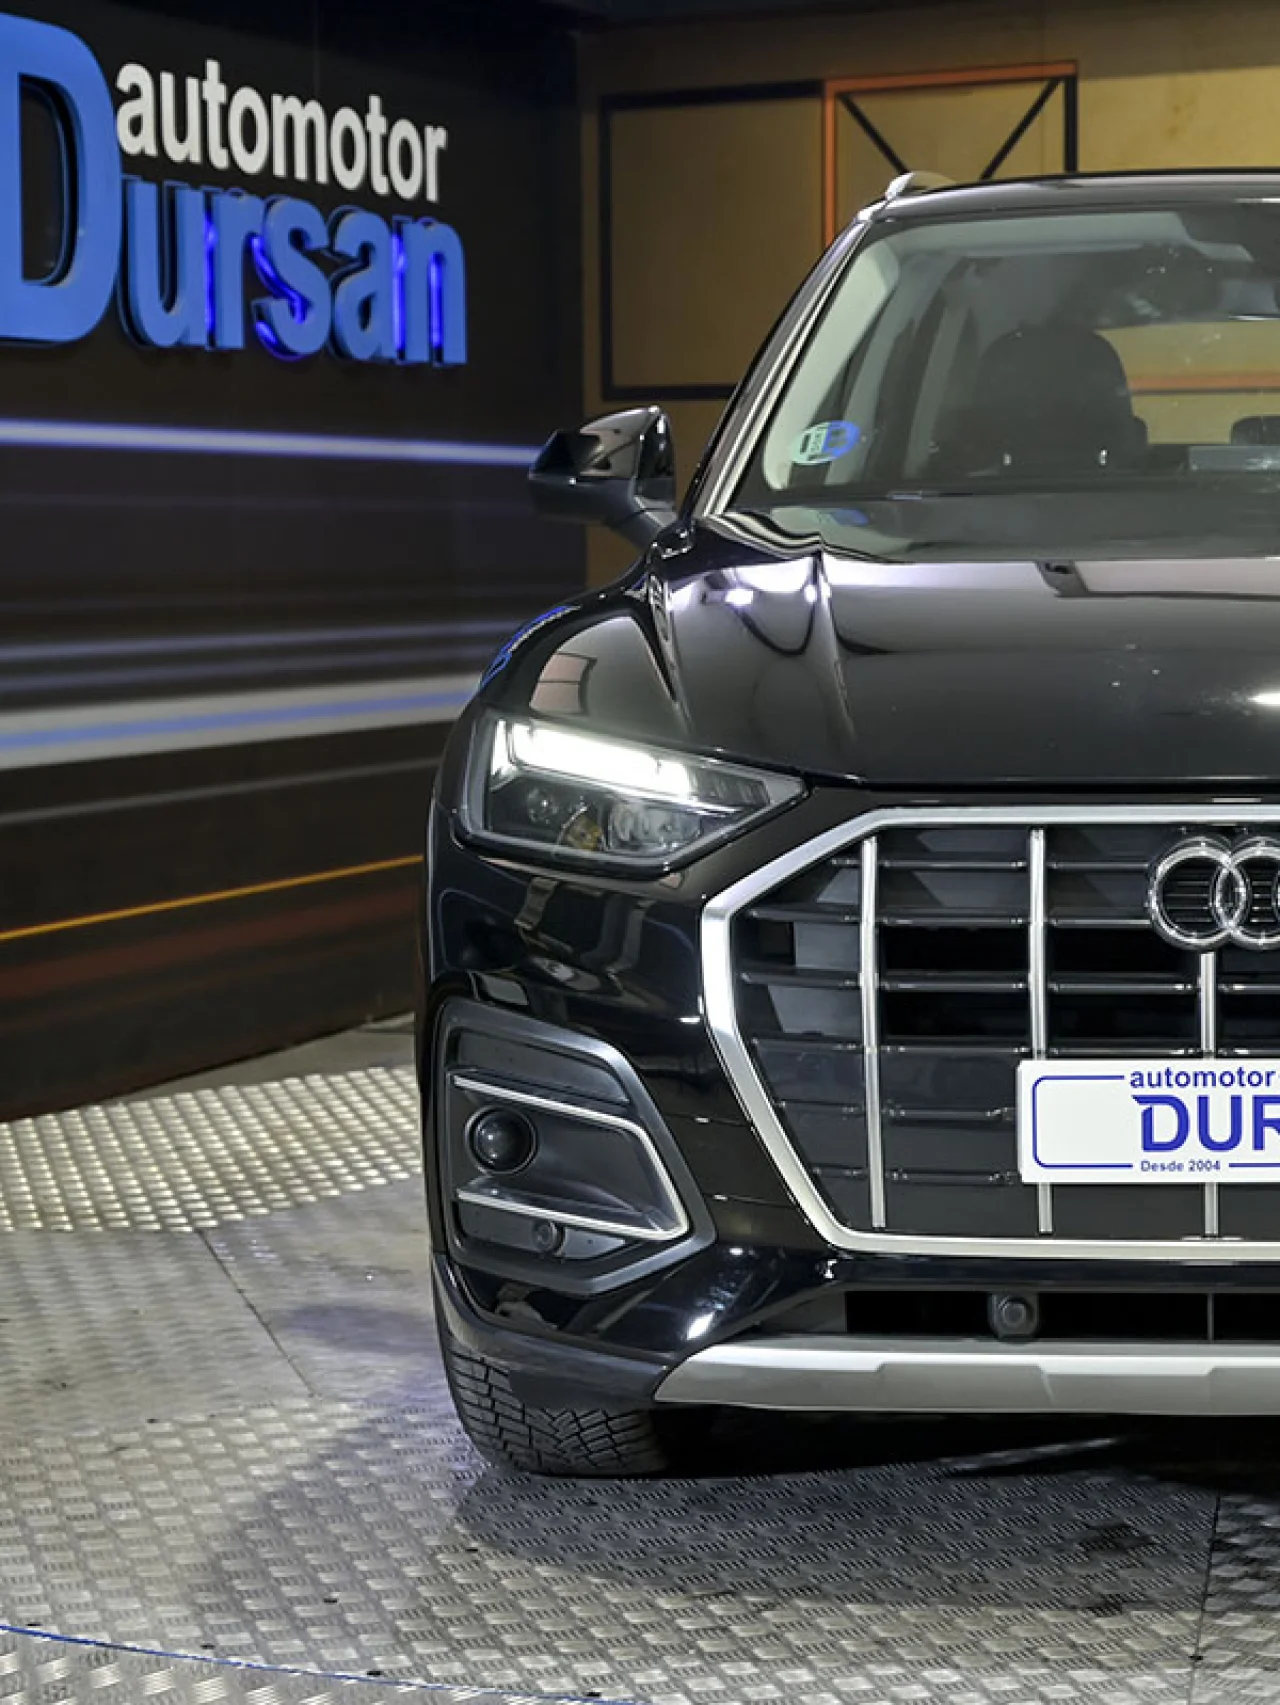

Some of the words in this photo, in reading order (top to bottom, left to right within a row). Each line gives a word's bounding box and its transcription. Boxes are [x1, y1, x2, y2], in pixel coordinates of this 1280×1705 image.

[116, 59, 447, 202] automotor
[0, 12, 467, 365] Dursan
[1130, 1066, 1276, 1088] automotor
[1140, 1160, 1183, 1171] Desde
[1188, 1160, 1221, 1172] 2004
